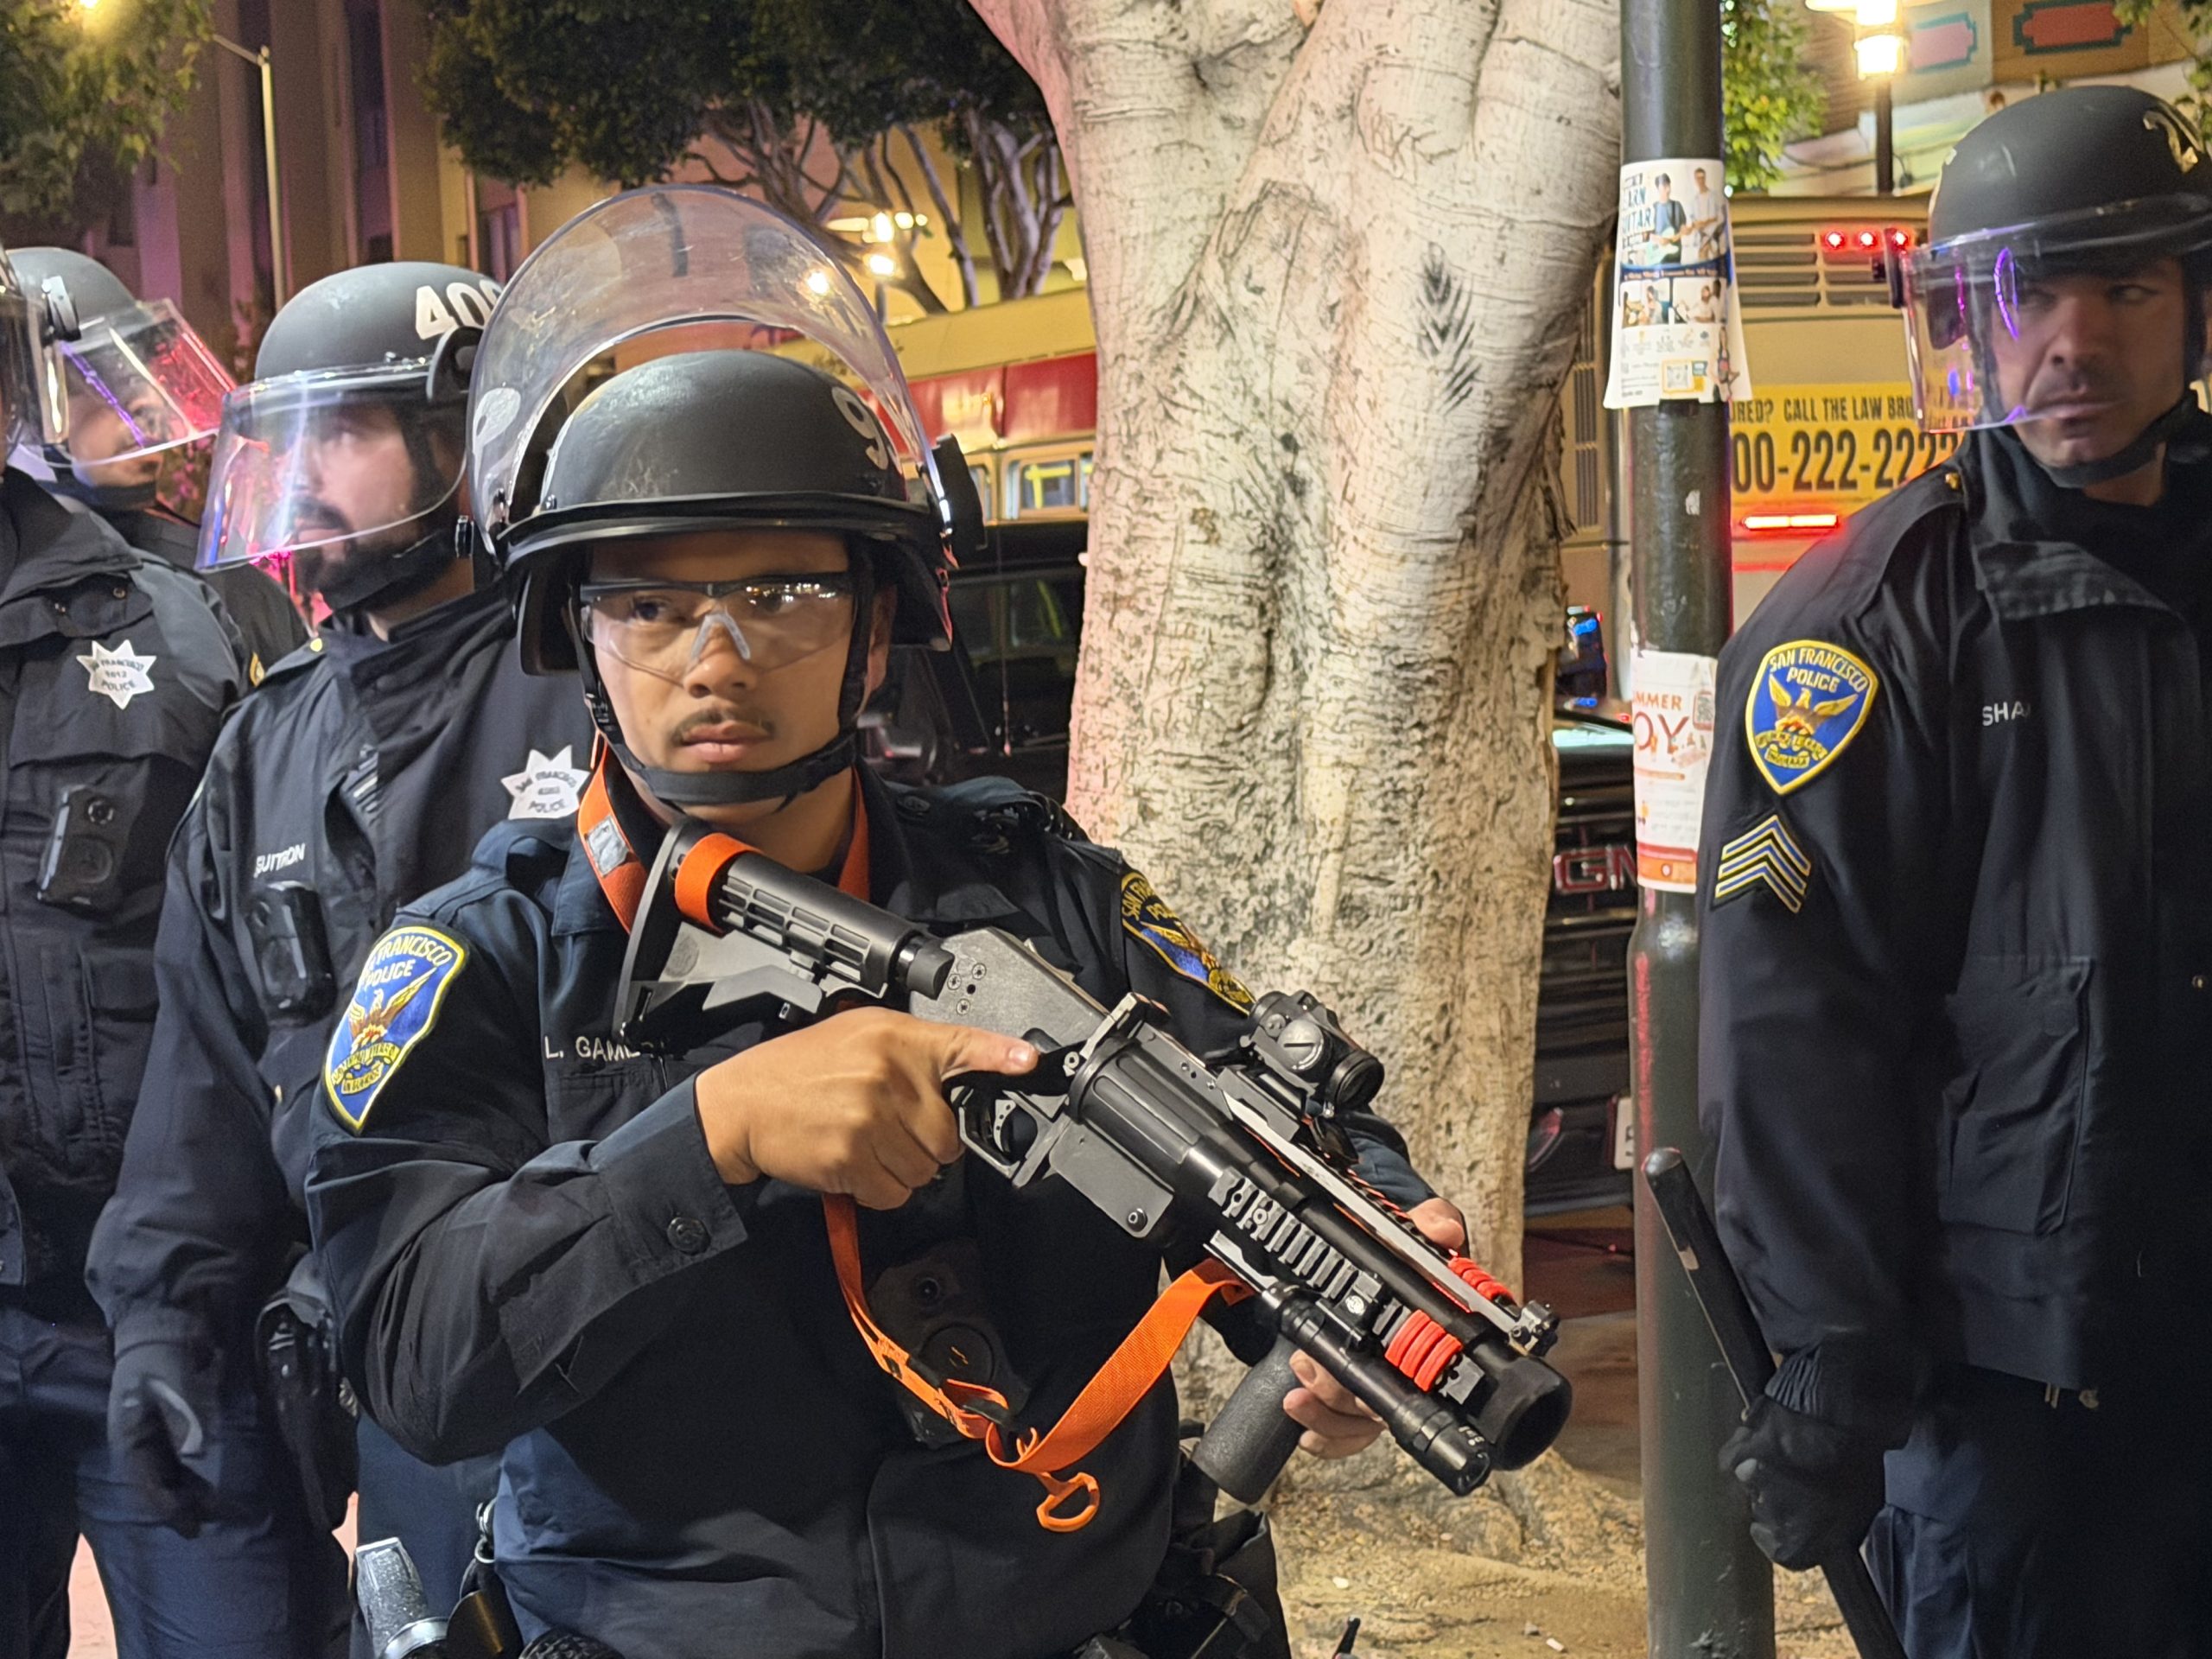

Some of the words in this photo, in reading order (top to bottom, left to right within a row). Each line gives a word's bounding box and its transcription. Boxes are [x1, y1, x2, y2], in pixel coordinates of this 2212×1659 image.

[1783, 397, 1817, 423] CALL
[1823, 397, 1847, 421] THE
[1852, 396, 1882, 421] LAW
[1770, 649, 1796, 673] SAN
[1798, 647, 1869, 693] FRANCISCO
[1786, 666, 1840, 693] POLICE
[1634, 691, 1681, 711] MMER
[1982, 701, 2031, 727] SHA
[375, 934, 453, 969] FRANCISCO
[363, 958, 416, 992] POLICE
[544, 1035, 564, 1059] L.
